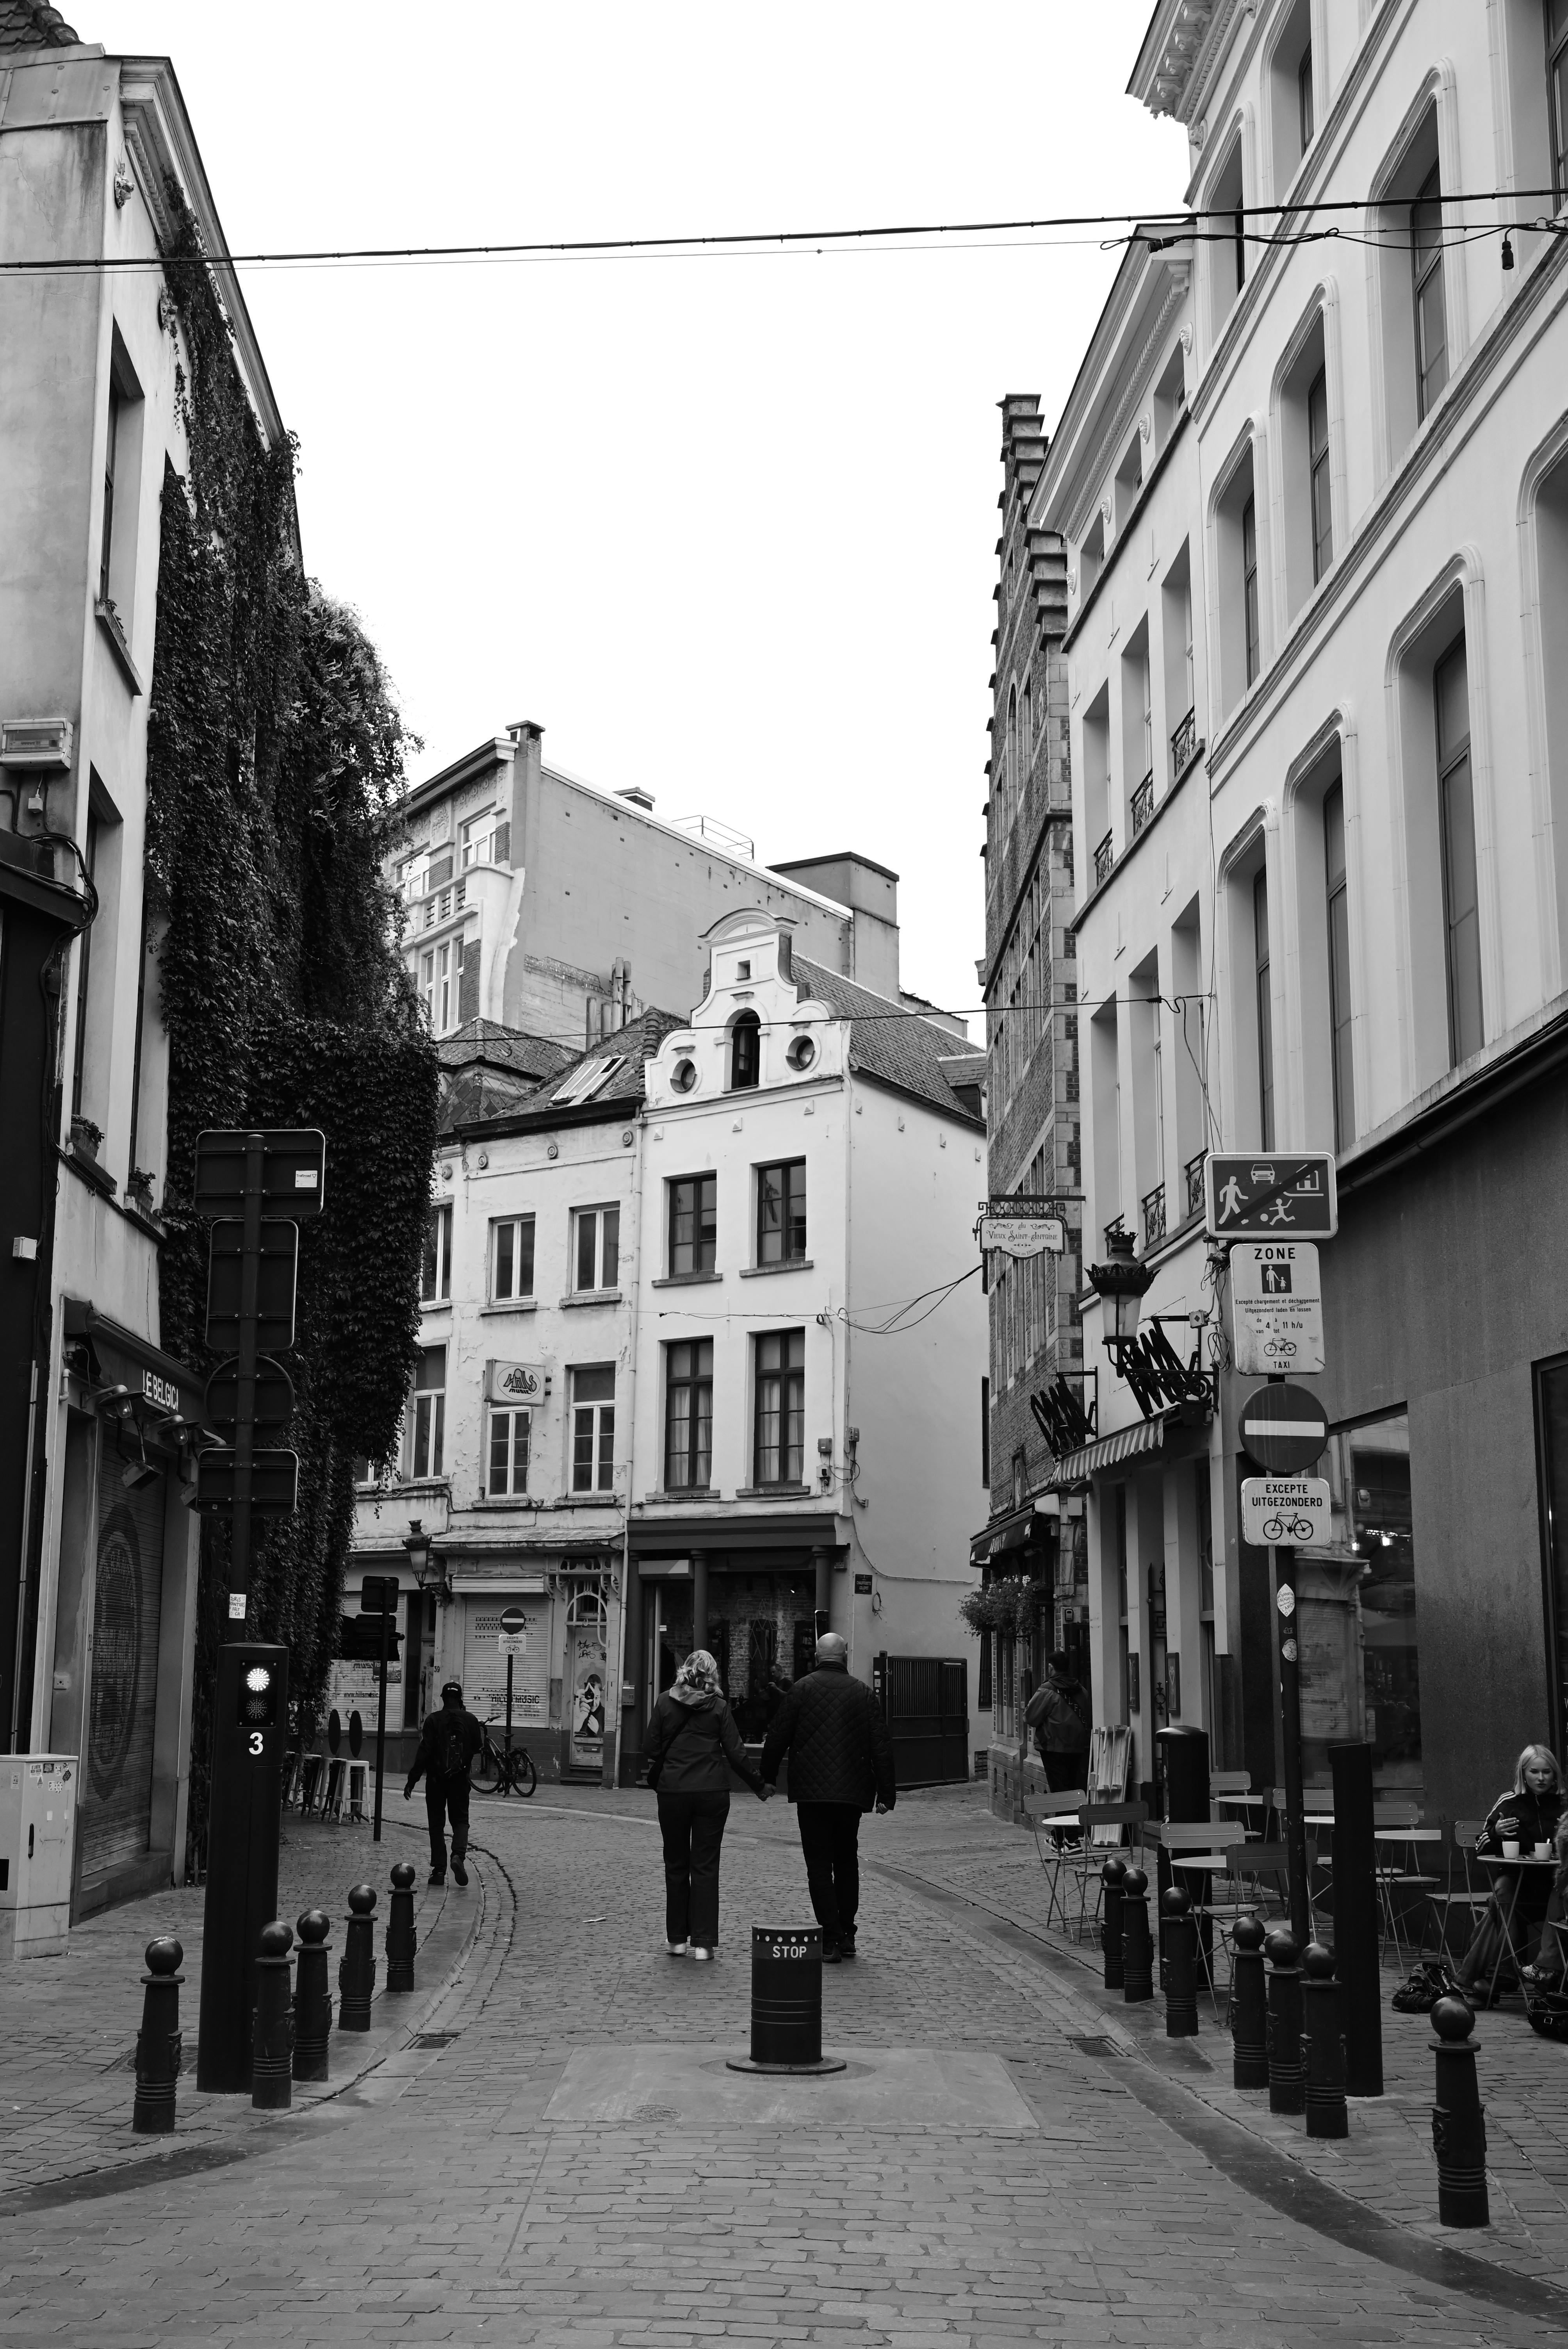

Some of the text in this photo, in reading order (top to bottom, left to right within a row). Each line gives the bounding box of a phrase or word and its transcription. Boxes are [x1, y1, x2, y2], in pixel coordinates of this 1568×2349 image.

[1254, 1248, 1295, 1260] ZONE
[143, 1369, 178, 1412] LE BELGICA
[1266, 1484, 1308, 1494] EXCEPTE
[1252, 1497, 1322, 1507] UITGEZONDERD
[515, 1695, 540, 1704] MUSIC
[248, 1732, 264, 1755] 3
[773, 1946, 807, 1958] STOP
